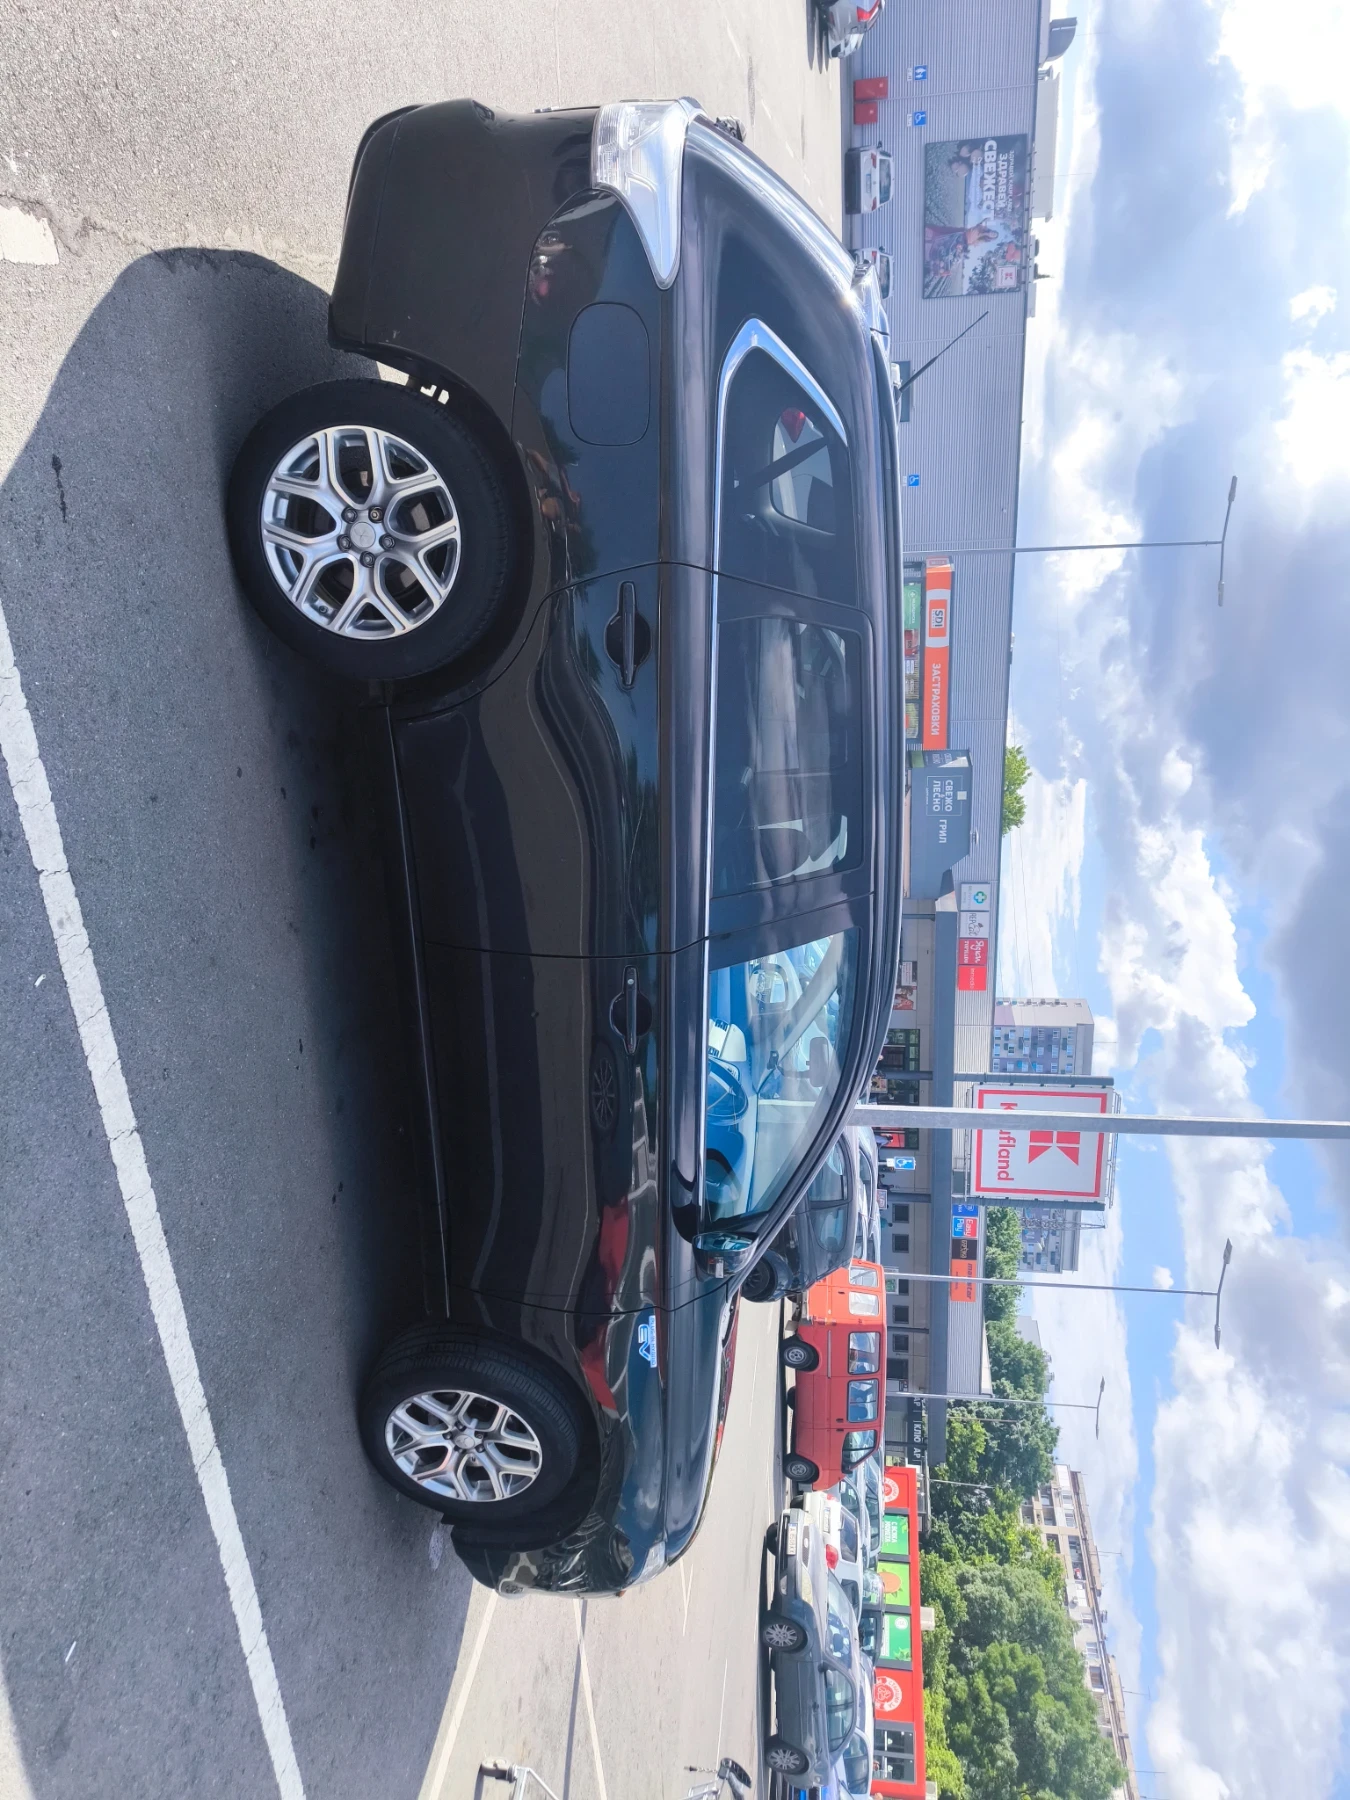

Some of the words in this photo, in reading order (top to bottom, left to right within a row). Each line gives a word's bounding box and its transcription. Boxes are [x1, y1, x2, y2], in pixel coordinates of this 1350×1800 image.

[996, 153, 1008, 210] ЗДРАВЕЙ,
[935, 610, 943, 627] SDI
[931, 663, 942, 736] ЗАСТРАХОВКИ
[932, 780, 941, 812] ЛЕСНО
[945, 780, 953, 812] СВЕЖО
[939, 819, 947, 843] ГРИЛ
[998, 1103, 1018, 1181] Kufland
[955, 1219, 963, 1232] Pay
[963, 1219, 973, 1236] Easy
[638, 1324, 650, 1361] EV
[913, 1424, 921, 1458] КЛЮАР
